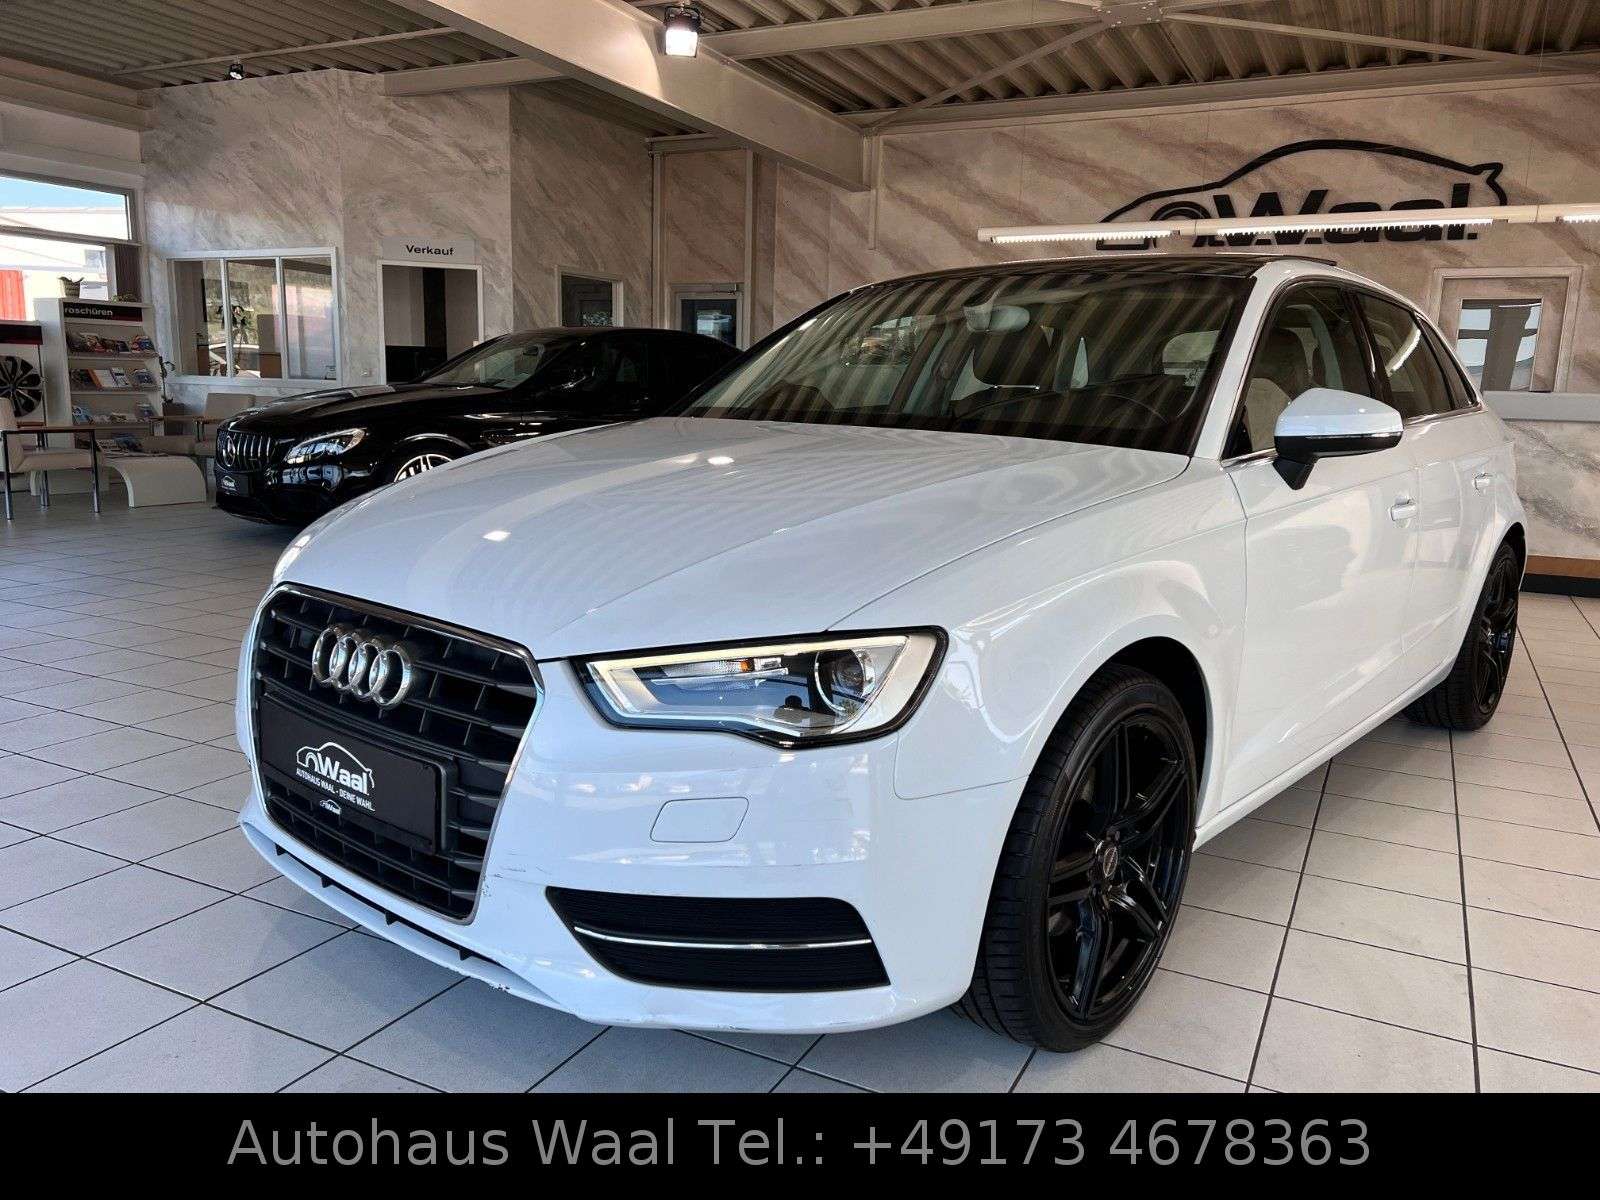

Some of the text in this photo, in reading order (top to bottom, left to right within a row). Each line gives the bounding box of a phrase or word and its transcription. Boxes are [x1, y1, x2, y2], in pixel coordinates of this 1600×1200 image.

[405, 244, 455, 256] Verkauf
[64, 306, 113, 316] roschüren
[317, 752, 368, 795] Waal
[355, 796, 376, 812] WAHL
